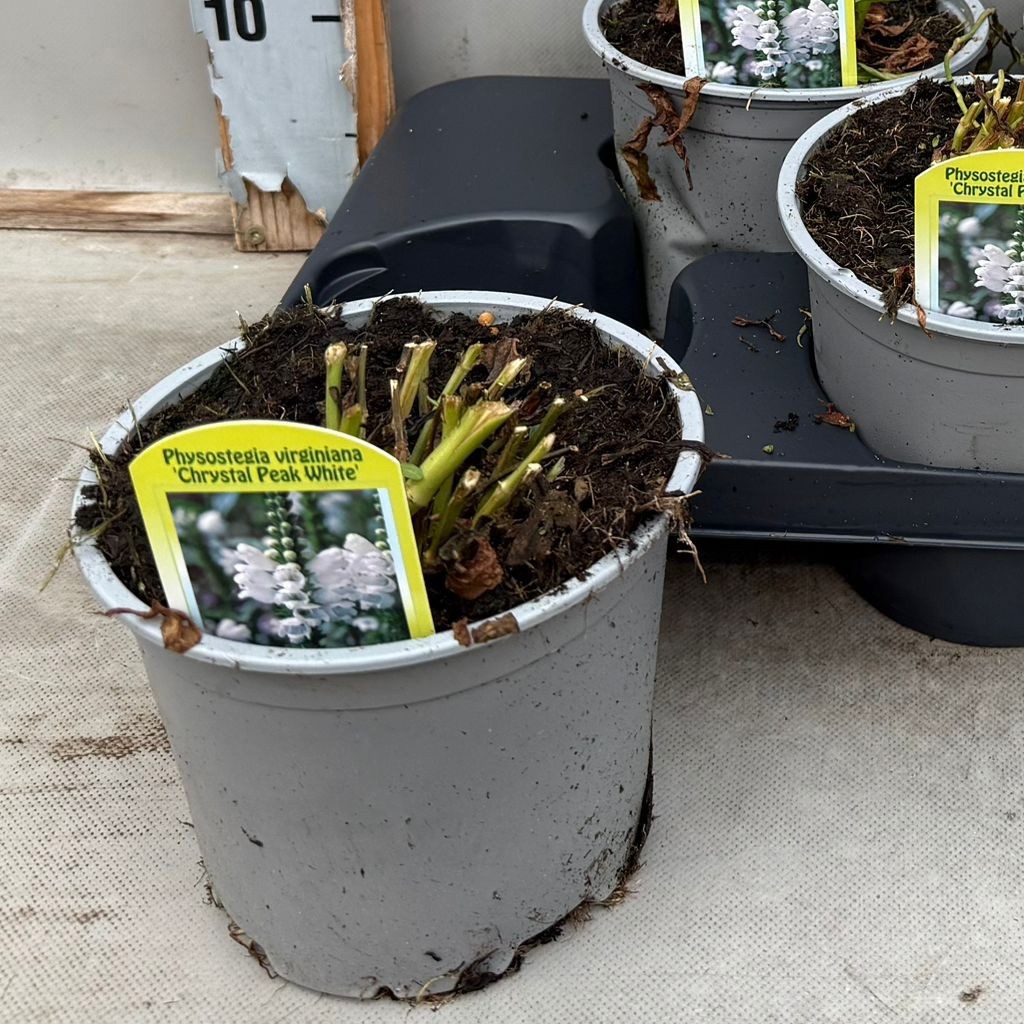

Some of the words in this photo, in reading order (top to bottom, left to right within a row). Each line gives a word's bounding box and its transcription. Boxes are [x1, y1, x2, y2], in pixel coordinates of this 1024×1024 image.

[950, 181, 1012, 198] 'Chrystal
[162, 447, 270, 466] Physostegia
[275, 445, 363, 463] virginiana
[173, 465, 253, 484] 'Chrystal
[257, 465, 302, 483] Peak
[304, 463, 360, 482] White'
